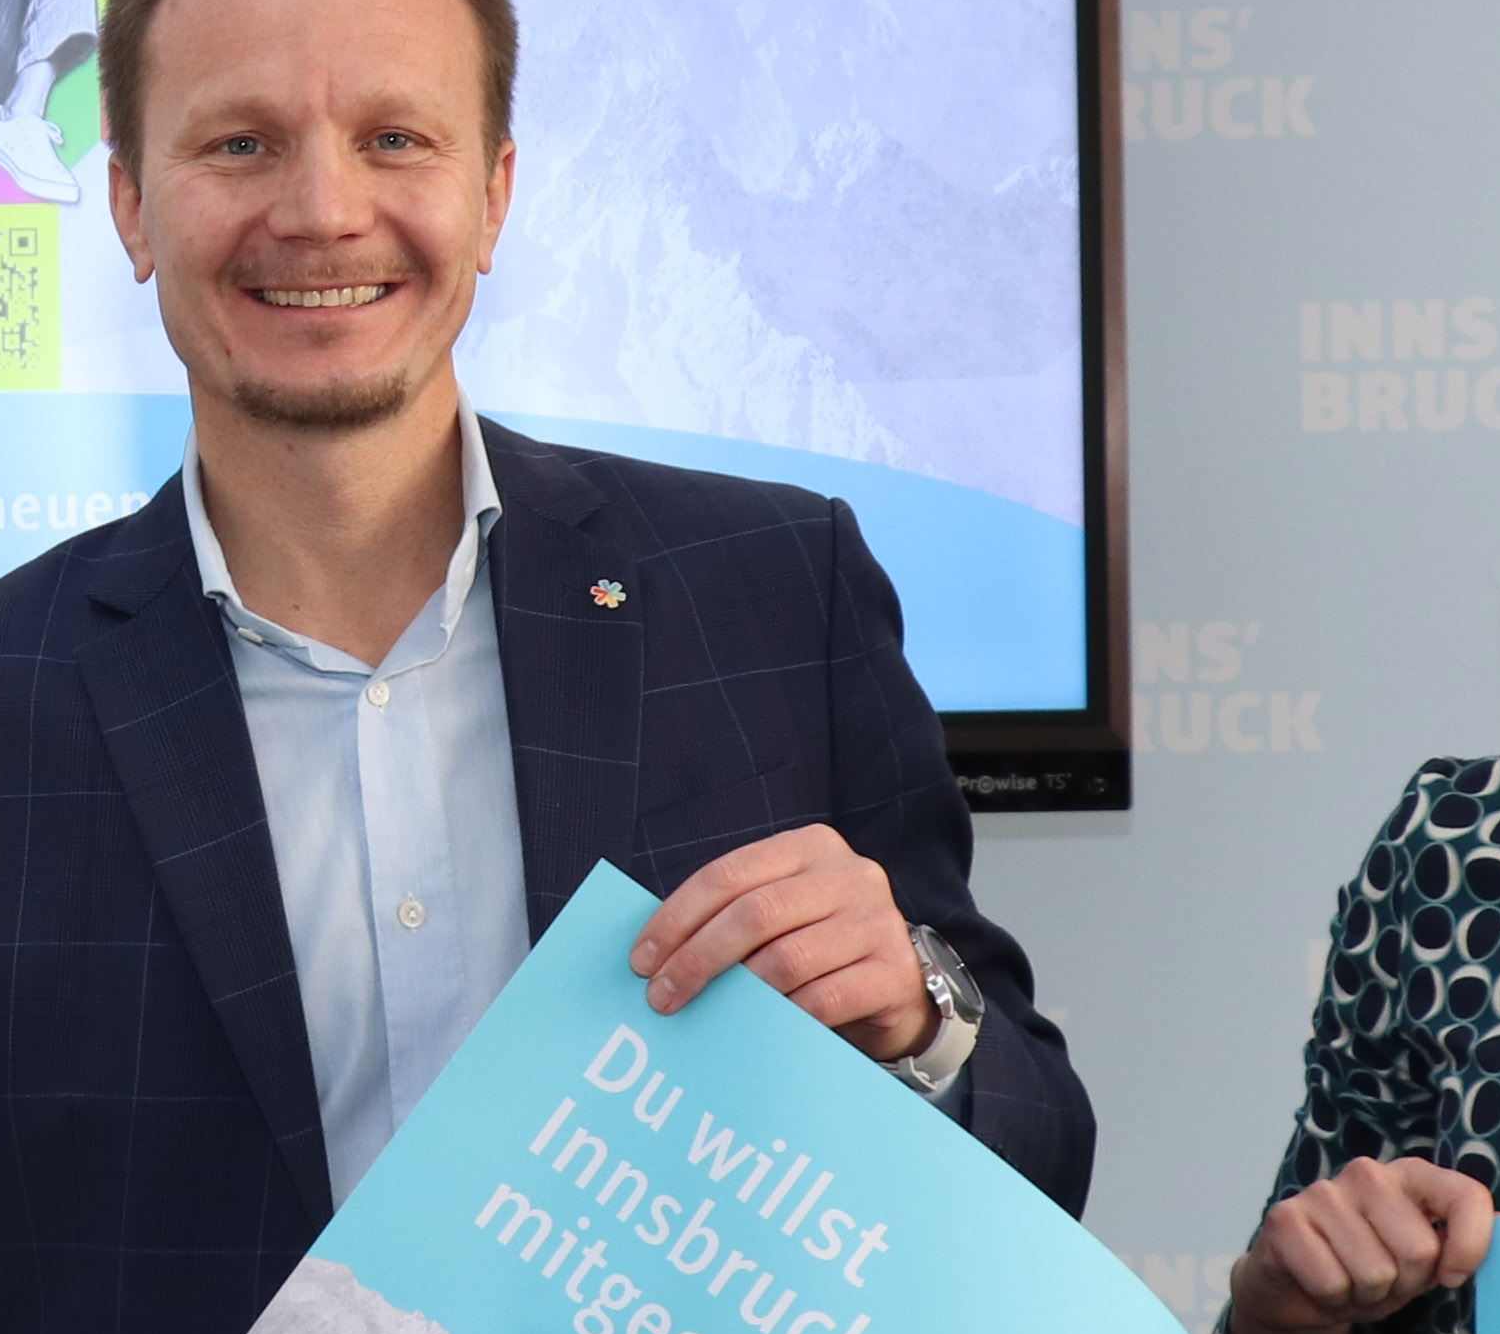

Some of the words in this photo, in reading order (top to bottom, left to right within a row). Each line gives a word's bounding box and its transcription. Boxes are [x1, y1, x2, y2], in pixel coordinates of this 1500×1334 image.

[1130, 7, 1252, 70] NS'
[1135, 619, 1264, 685] NS'
[583, 1023, 685, 1133] Du
[688, 1110, 891, 1289] willst
